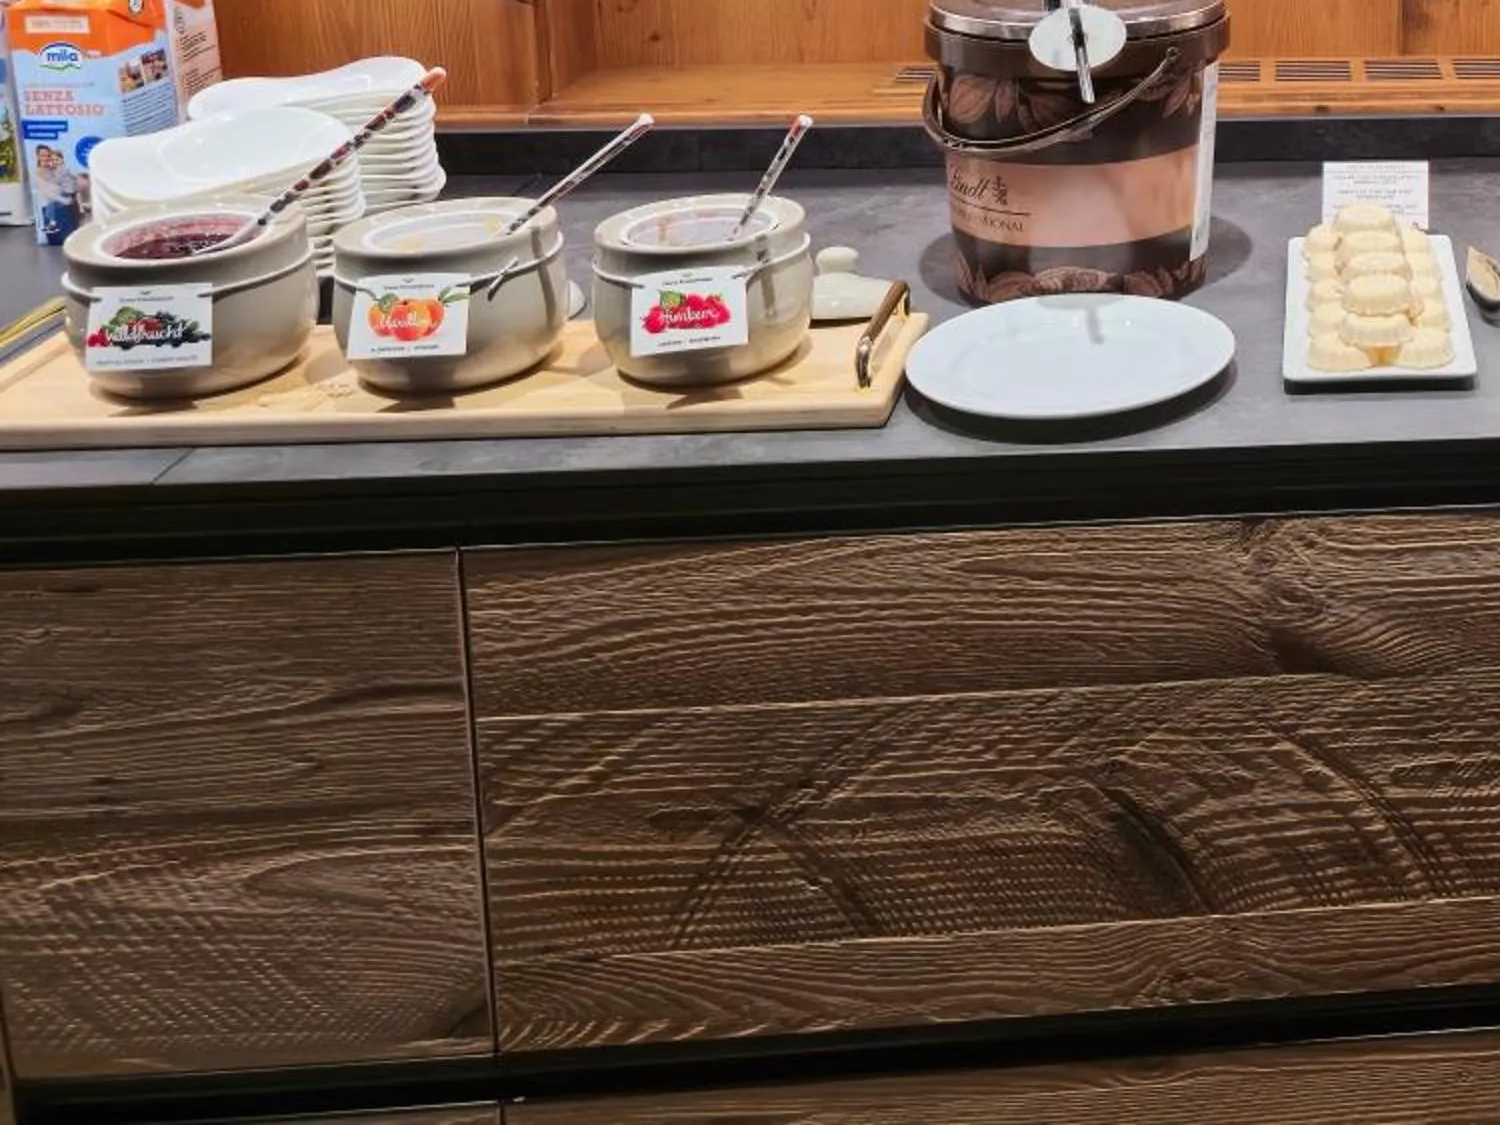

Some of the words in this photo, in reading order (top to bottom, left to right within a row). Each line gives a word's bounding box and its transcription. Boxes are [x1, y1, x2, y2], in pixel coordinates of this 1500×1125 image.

[47, 48, 79, 63] mila
[23, 90, 75, 103] SENZA
[25, 104, 104, 116] LATTOSIO
